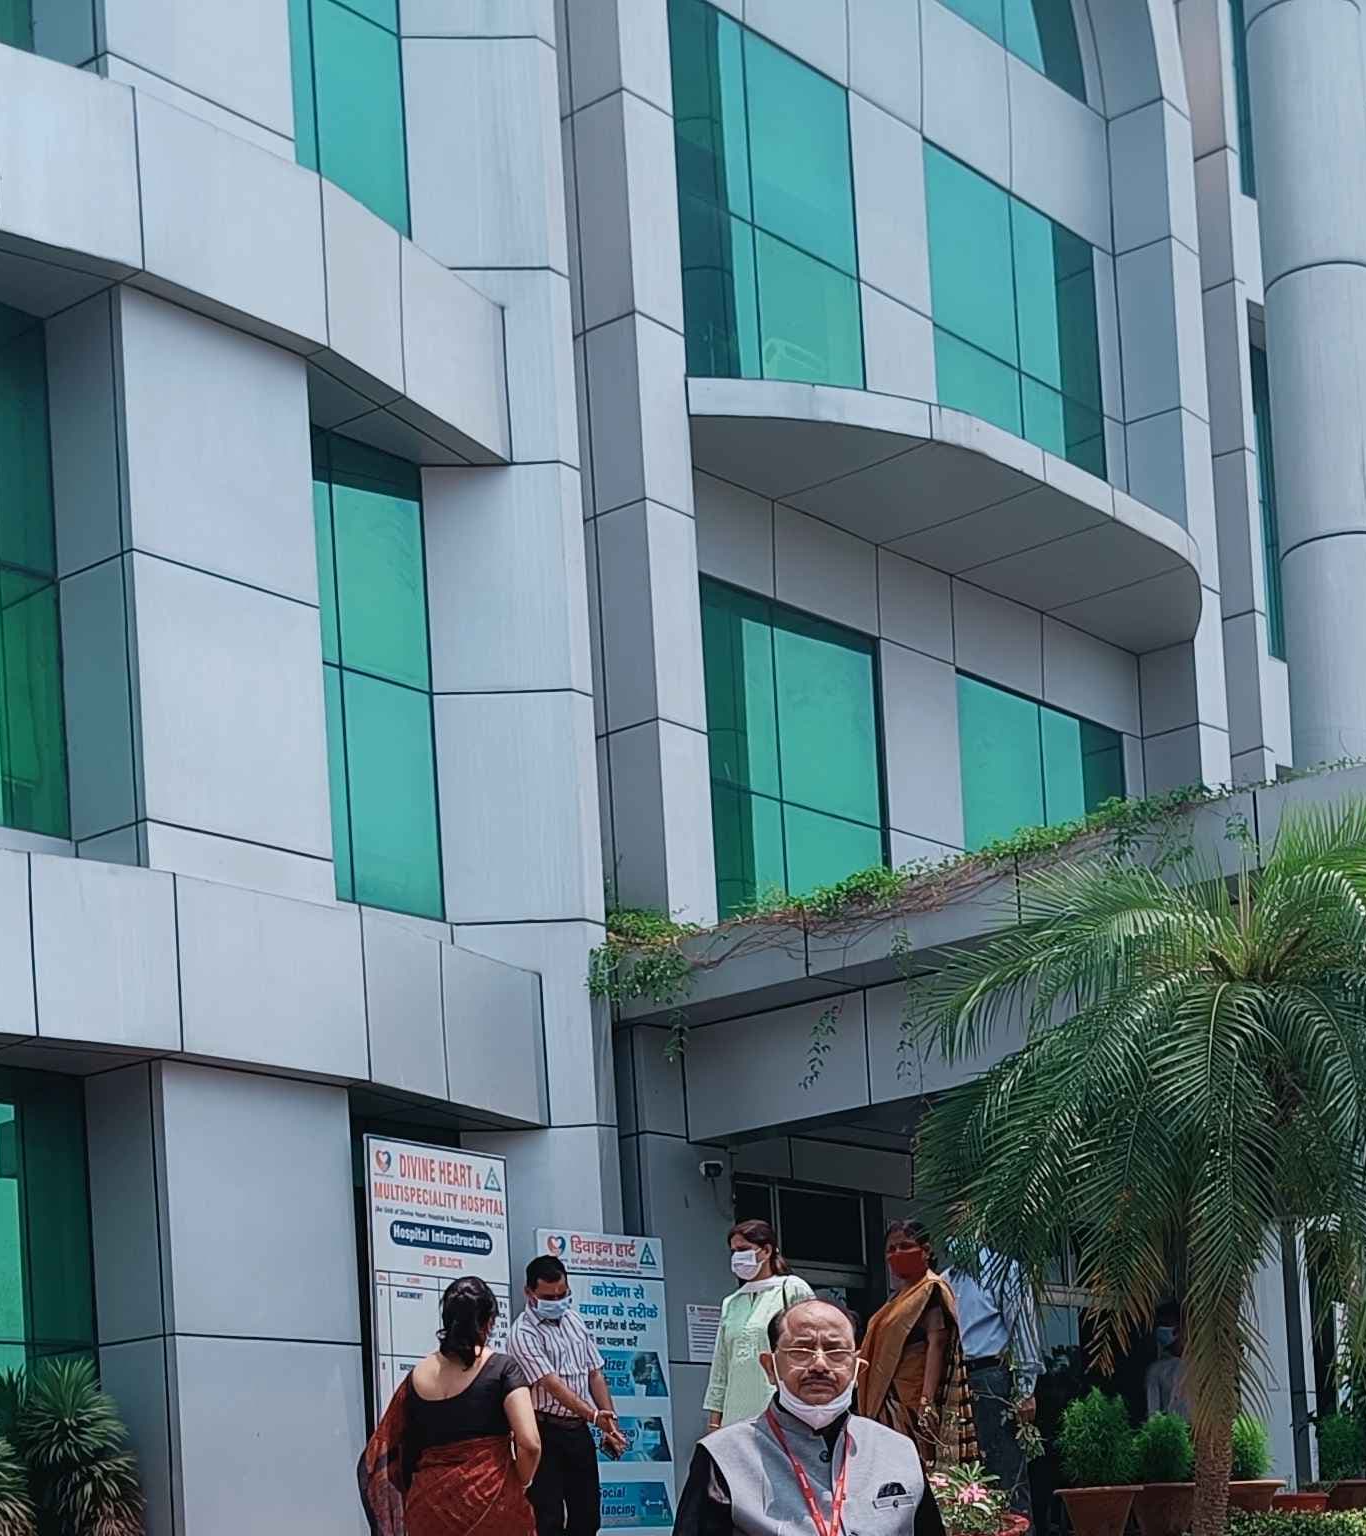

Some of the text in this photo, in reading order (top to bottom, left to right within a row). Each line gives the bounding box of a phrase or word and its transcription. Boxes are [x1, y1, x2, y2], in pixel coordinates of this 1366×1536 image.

[399, 1153, 436, 1183] DIVINE
[439, 1159, 472, 1189] HEART
[374, 1182, 504, 1216] MULTISPECIALITY HOSPITAL
[393, 1224, 490, 1250] Hospital Infrastructure
[570, 1234, 635, 1257] डिवाइन हार्ट
[592, 1281, 644, 1299] कोरोना से
[579, 1302, 658, 1319] बचाव के तरीके
[601, 1487, 626, 1498] ocial
[601, 1504, 635, 1516] tancing
